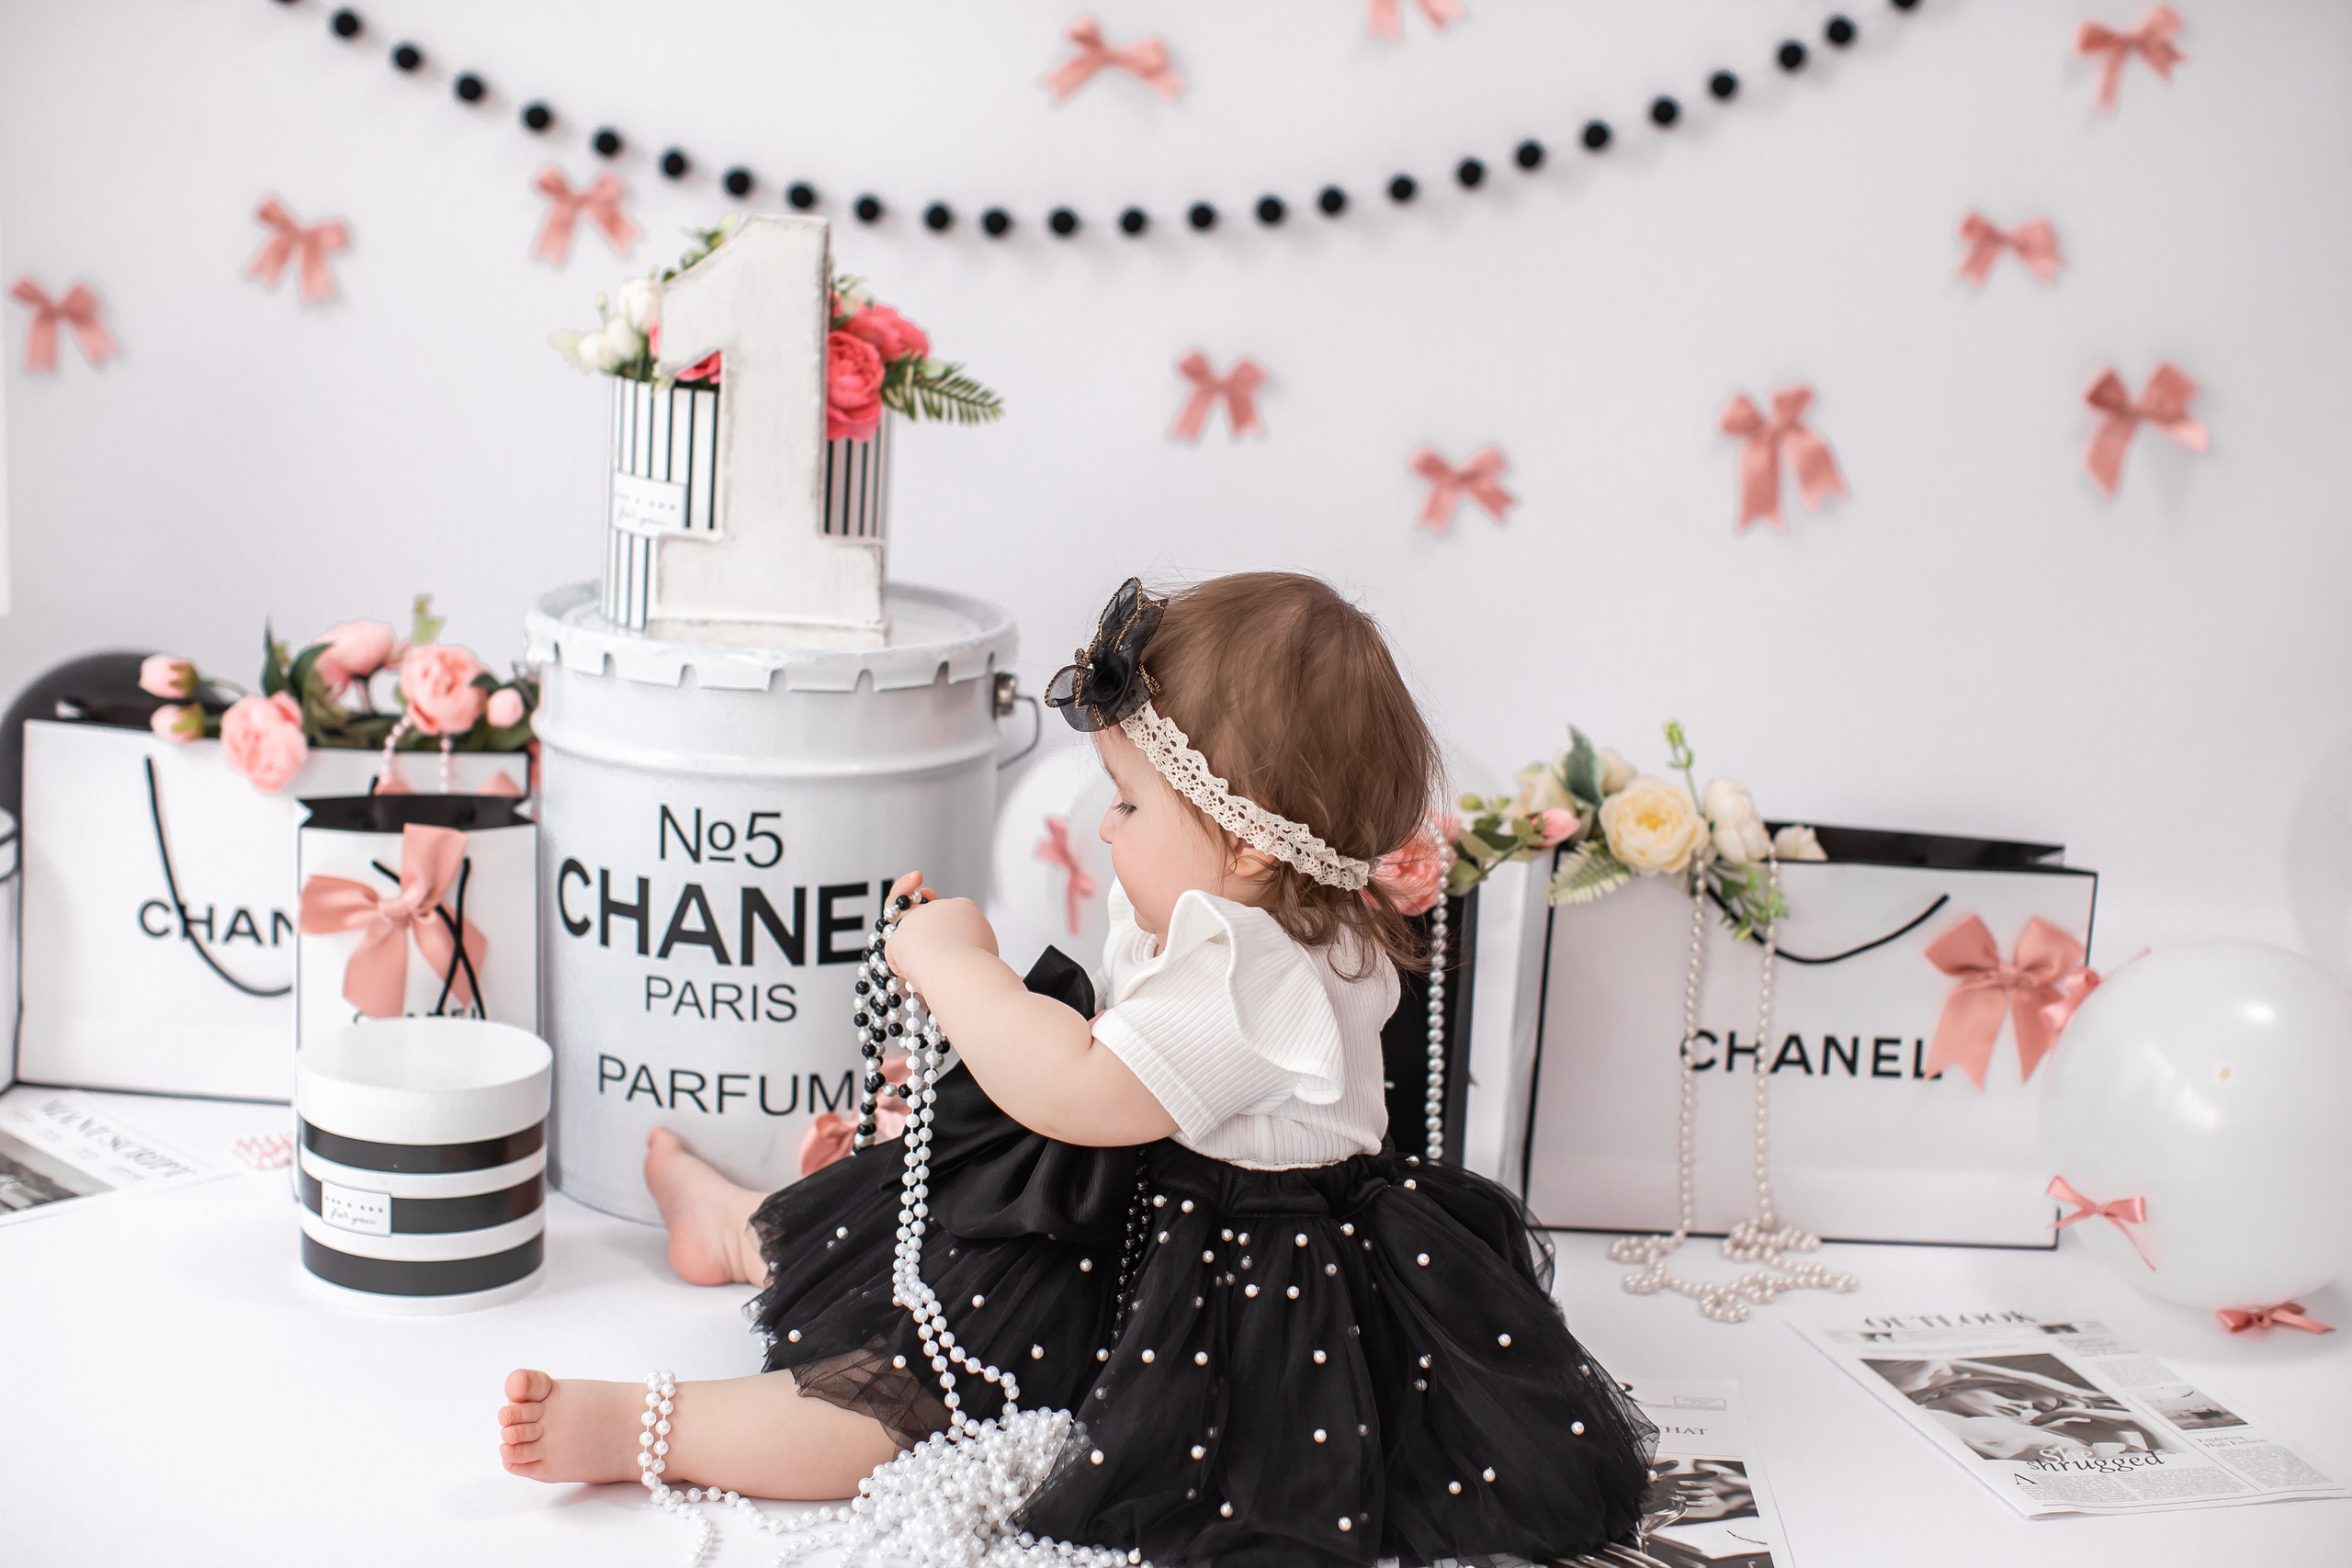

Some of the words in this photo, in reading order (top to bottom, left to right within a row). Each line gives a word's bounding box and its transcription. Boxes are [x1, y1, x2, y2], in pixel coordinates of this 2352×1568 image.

[659, 214, 886, 647] 1
[557, 858, 896, 966] CHANE
[645, 975, 798, 1023] PARIS
[1679, 1028, 1943, 1079] CHANEL
[598, 1053, 854, 1116] PARFUM
[2014, 1472, 2039, 1485] A
[2027, 1450, 2165, 1474] shrugged
[2039, 1447, 2097, 1463] She
